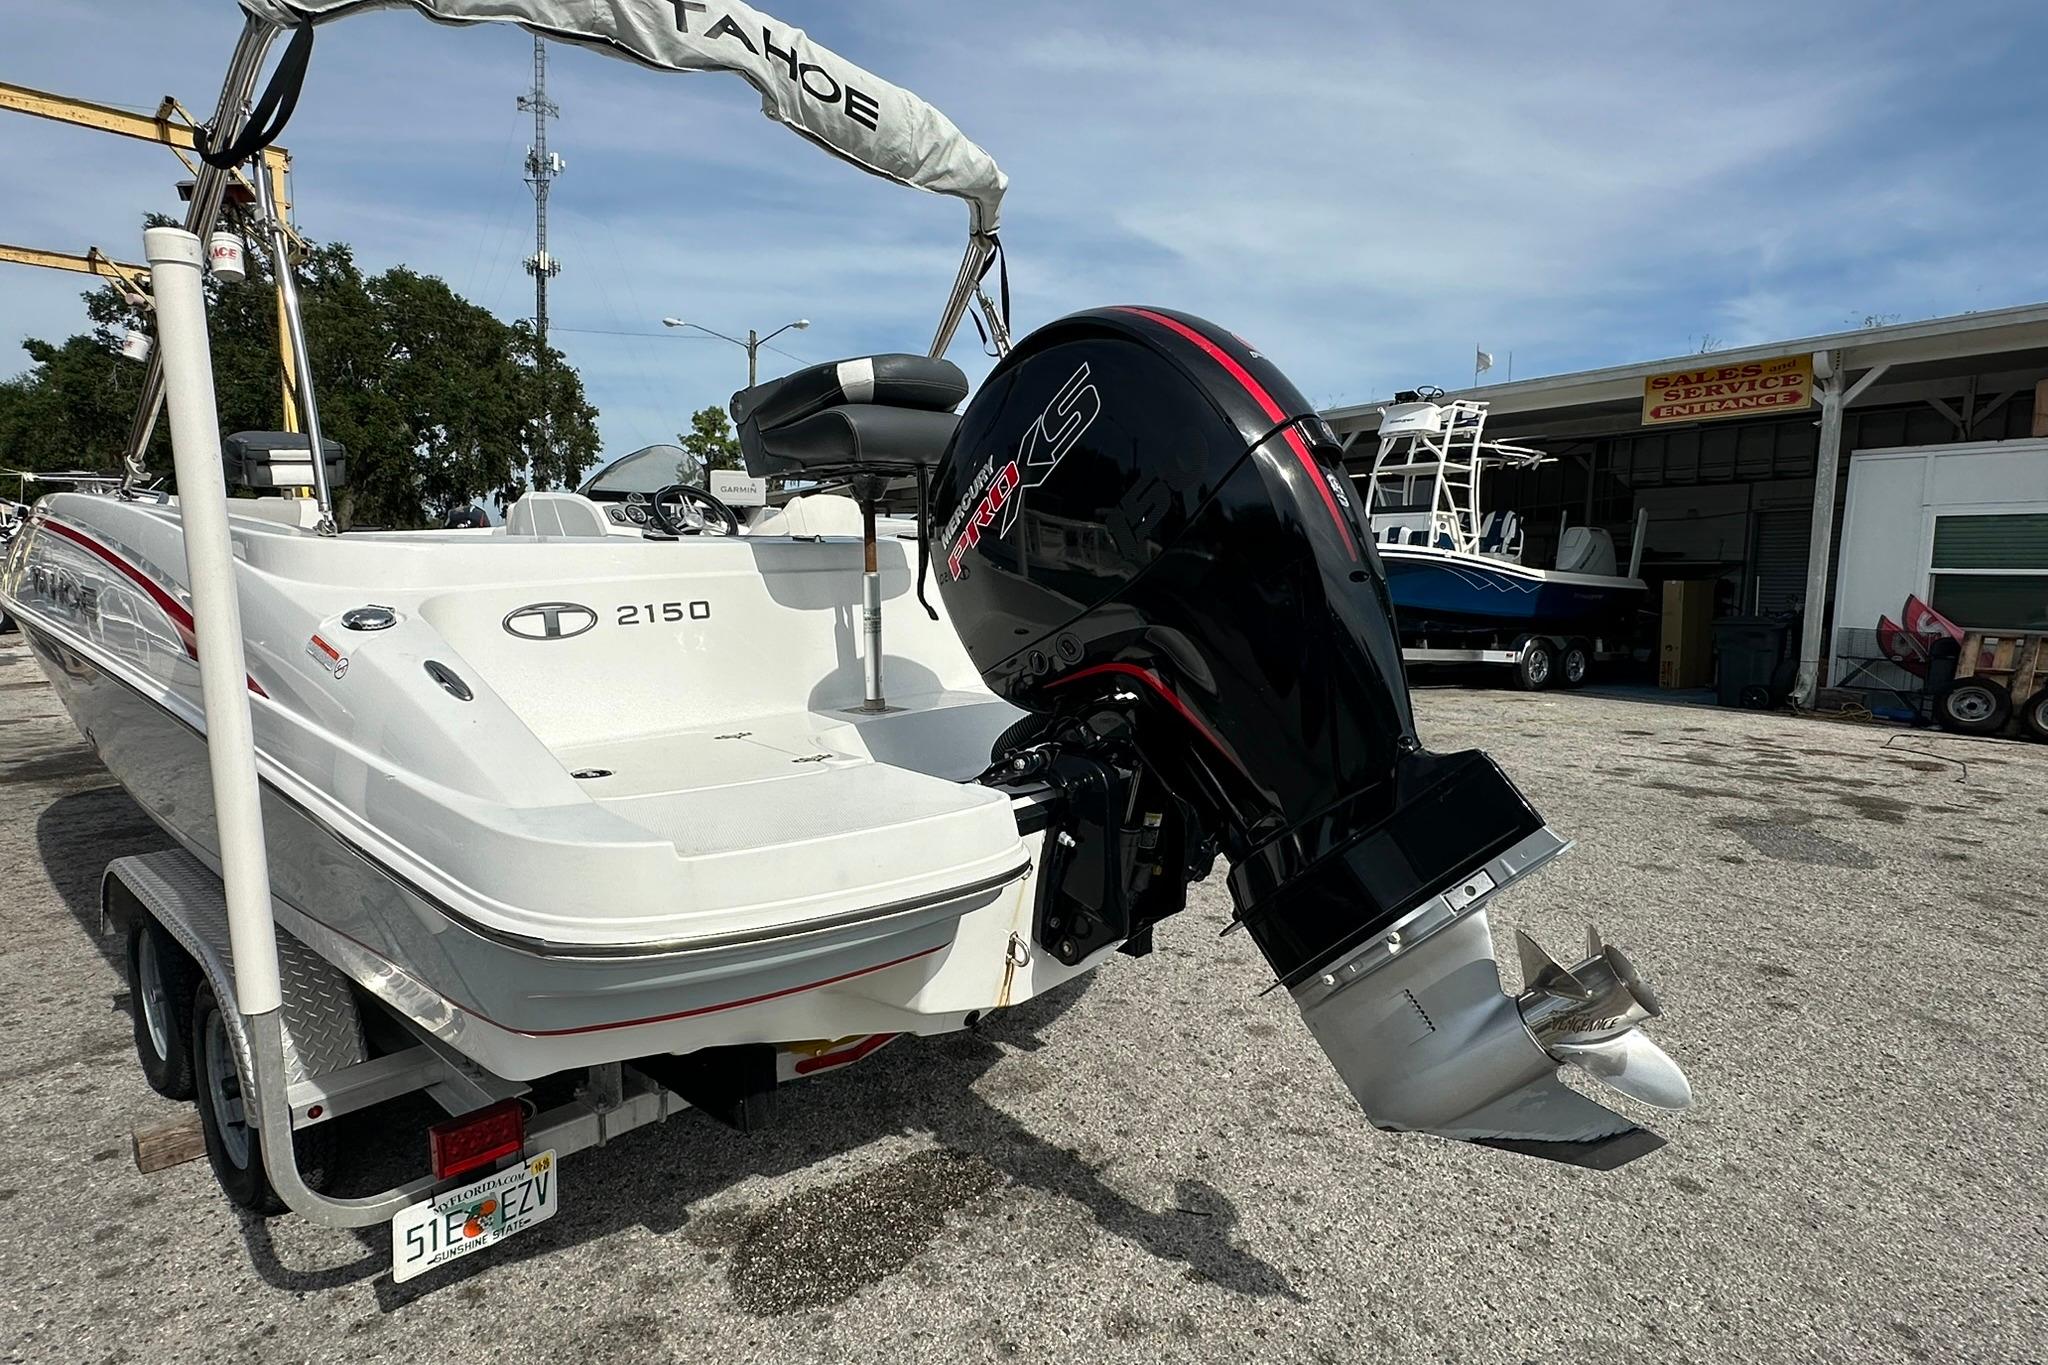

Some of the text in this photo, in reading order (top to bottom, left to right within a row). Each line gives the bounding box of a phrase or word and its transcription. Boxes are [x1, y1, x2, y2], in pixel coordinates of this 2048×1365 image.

[666, 0, 879, 132] TAHOE
[212, 247, 237, 257] ACE
[1652, 360, 1796, 390] SALES and
[1664, 373, 1803, 401] SERVICE
[1659, 392, 1791, 417] ENTRANCE
[947, 361, 1100, 582] PRO XS
[720, 484, 757, 493] GARMIN
[941, 455, 994, 550] MERCURY
[616, 600, 710, 625] 2150
[1551, 1017, 1619, 1033] VENGEANCE
[433, 1172, 525, 1214] MYFLORIDA.COM
[407, 1171, 549, 1262] 51E EZV
[434, 1219, 525, 1262] SUNSHINE STATE
